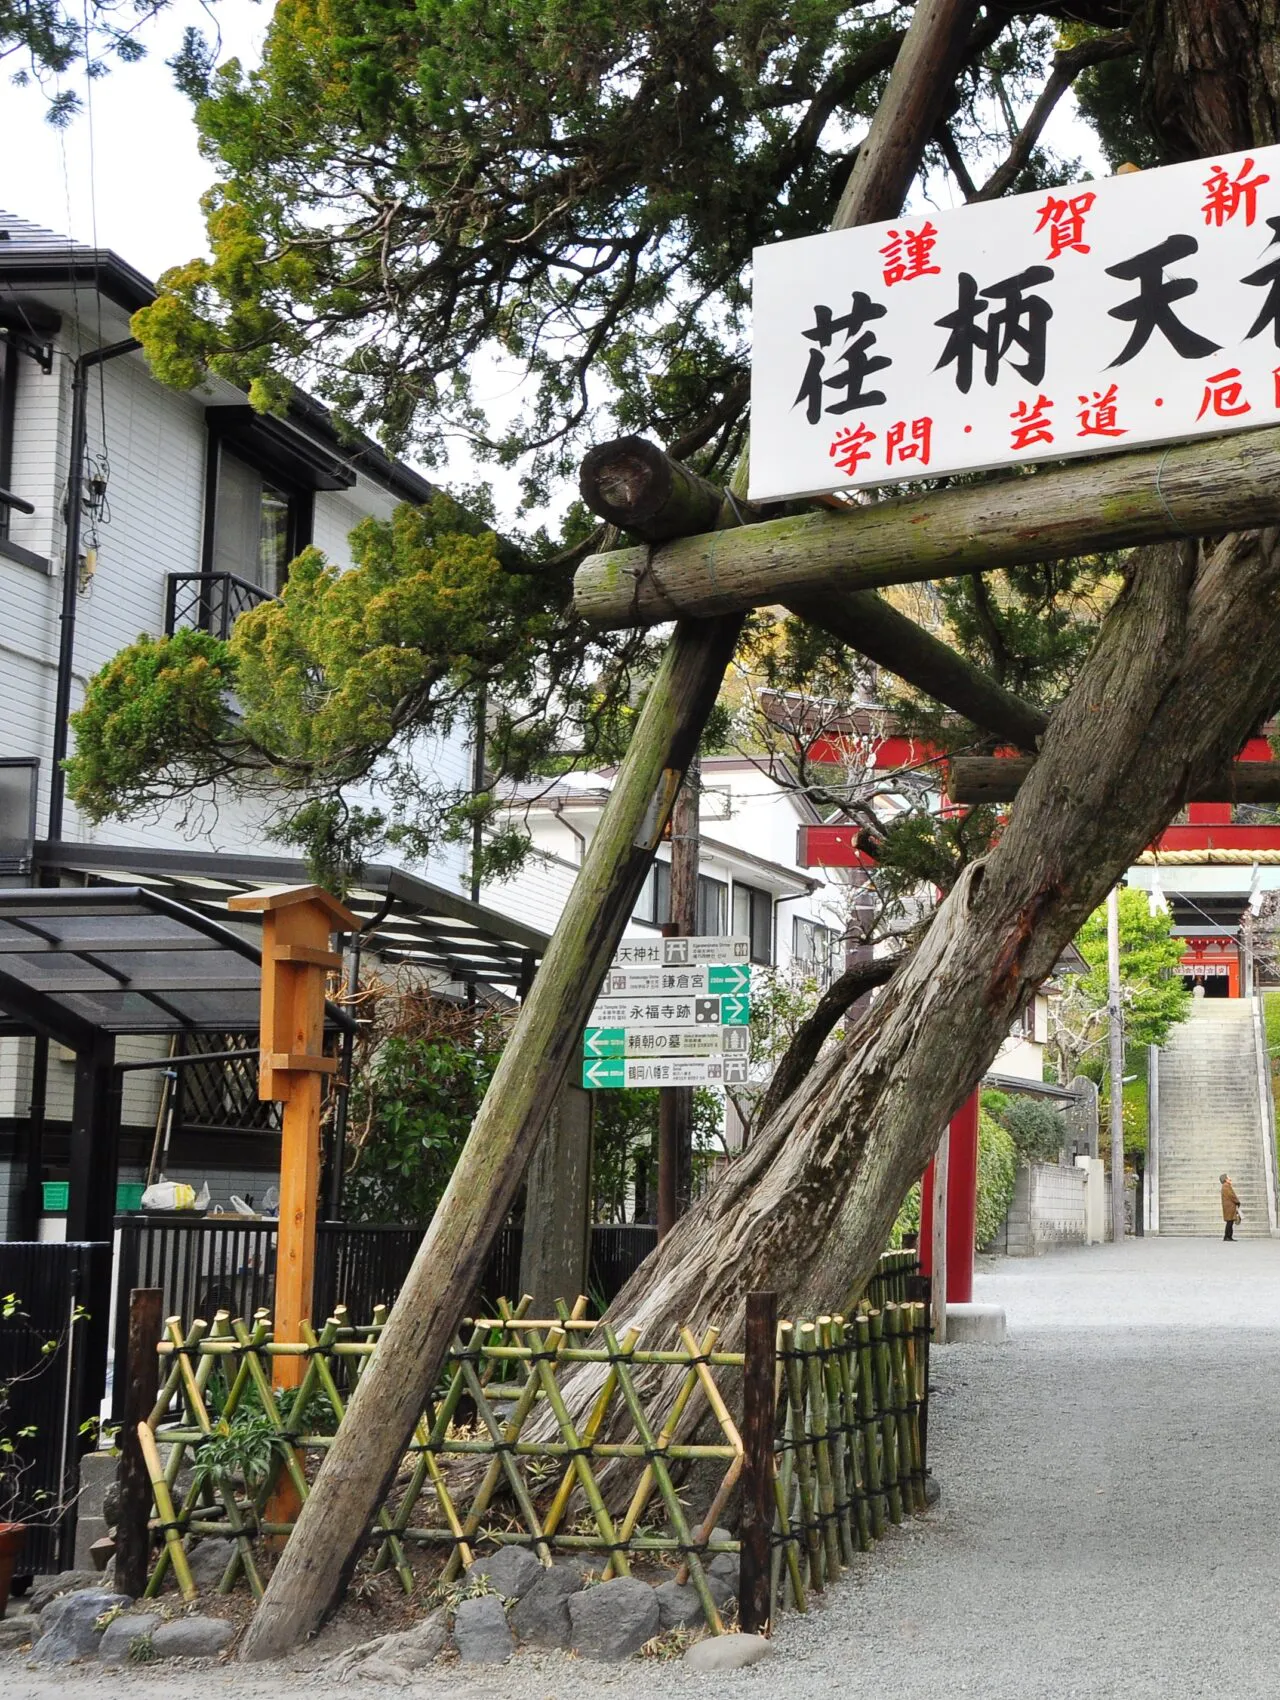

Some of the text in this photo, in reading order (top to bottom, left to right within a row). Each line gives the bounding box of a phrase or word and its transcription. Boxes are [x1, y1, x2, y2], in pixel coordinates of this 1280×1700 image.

[615, 946, 660, 962] 天神社
[662, 974, 704, 989] 鎌倉宮
[629, 1004, 691, 1019] 永福寺跡
[628, 1034, 681, 1049] 頼朝の墓
[628, 1065, 670, 1080] 鶴岡八幡宮
